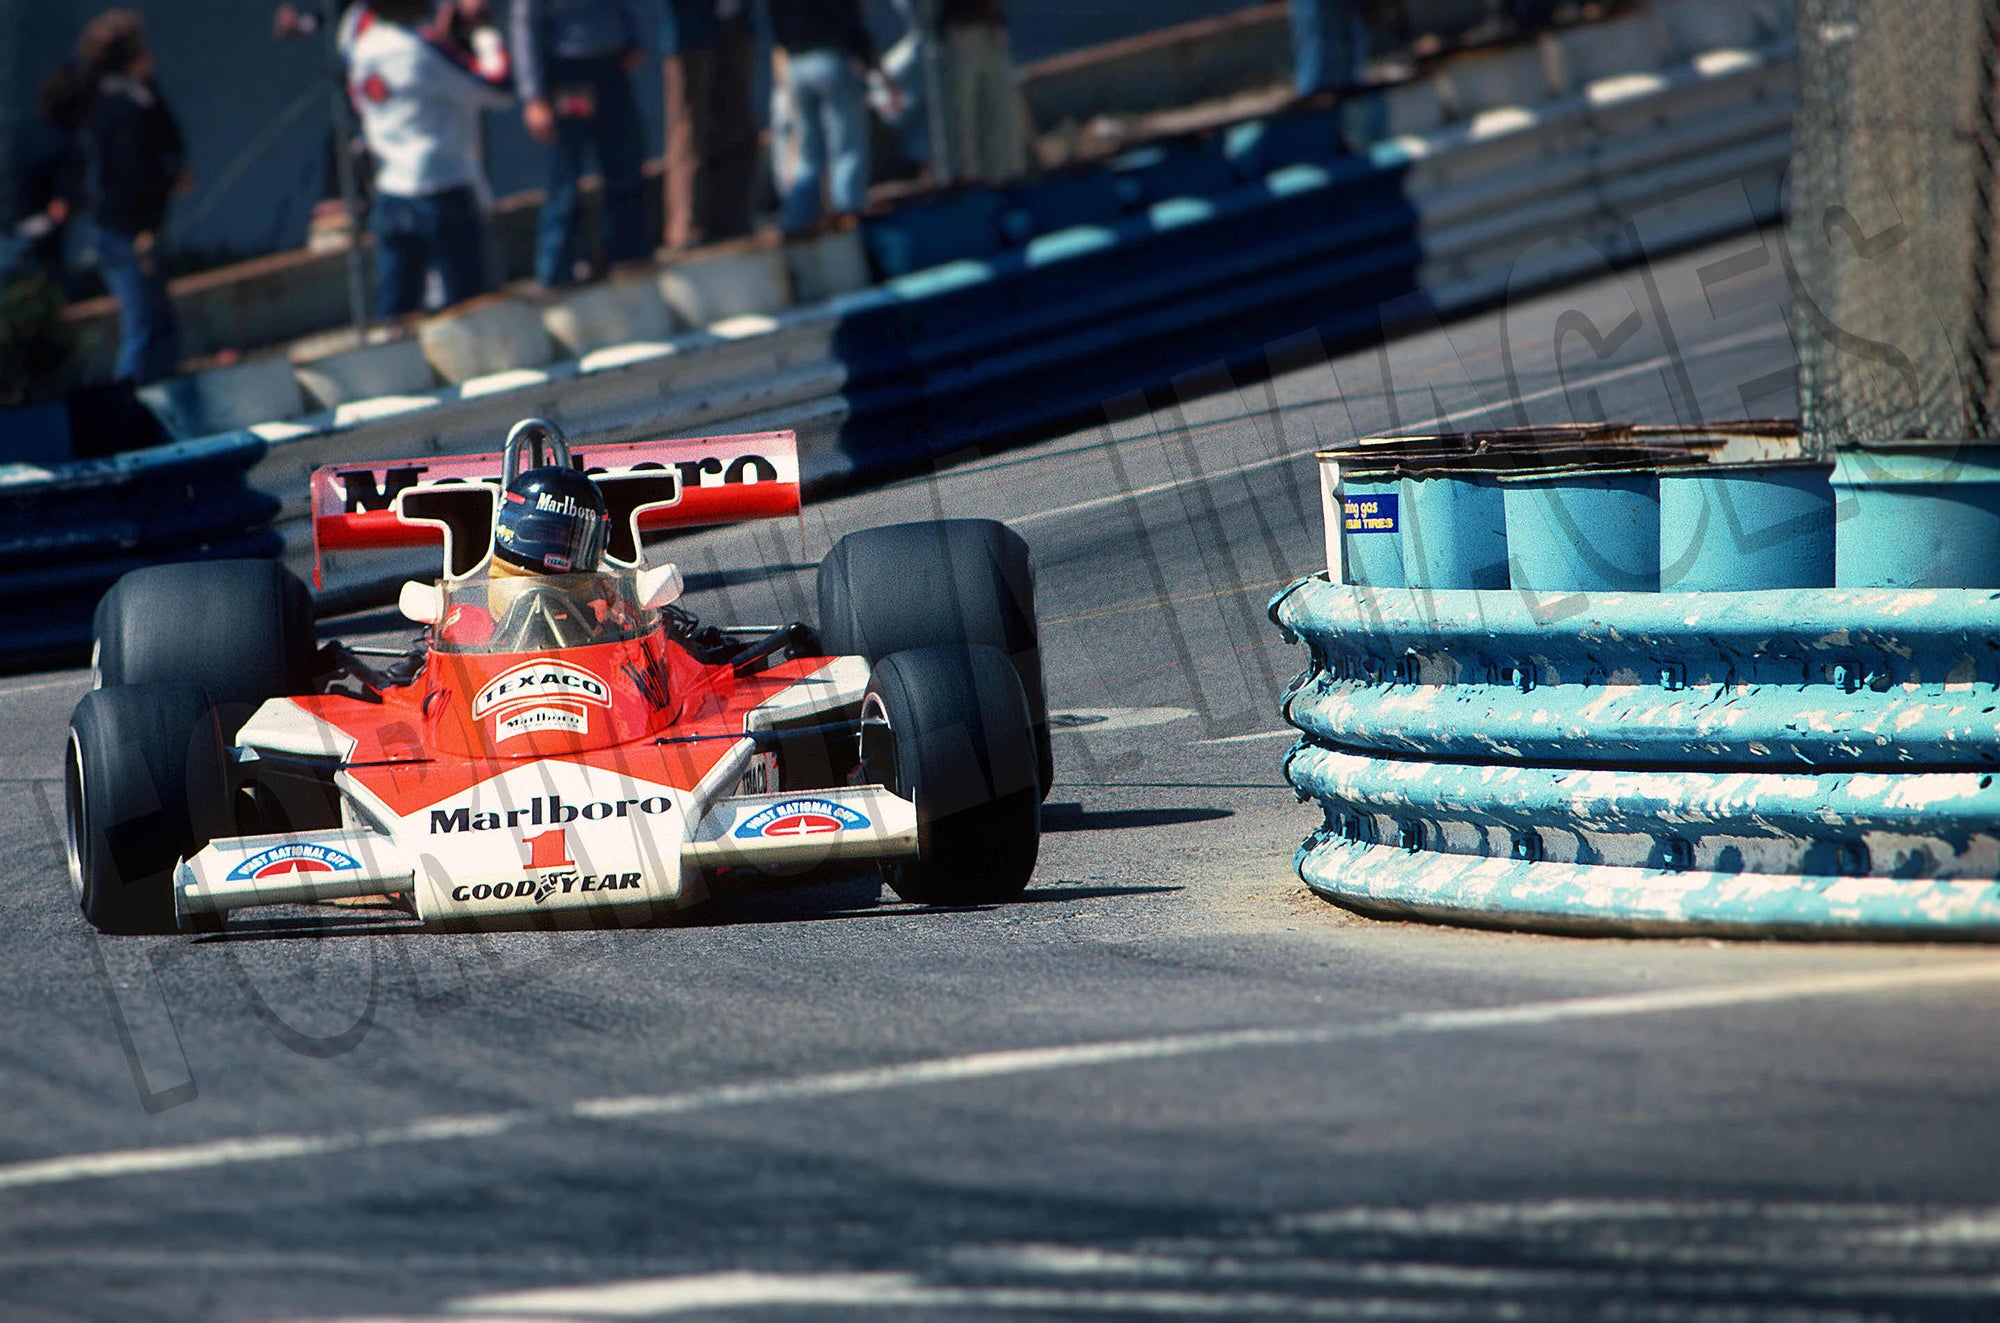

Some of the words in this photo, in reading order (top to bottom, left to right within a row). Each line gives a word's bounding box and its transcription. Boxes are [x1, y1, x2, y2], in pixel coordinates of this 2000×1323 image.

[535, 492, 597, 521] Marlboro
[1361, 502, 1378, 518] gas
[1363, 518, 1393, 529] TIRES
[482, 673, 602, 703] TEXACO
[430, 795, 672, 834] Marlboro
[776, 801, 832, 816] NATIONAL
[268, 845, 325, 861] NATIONAL
[522, 828, 575, 870] 1
